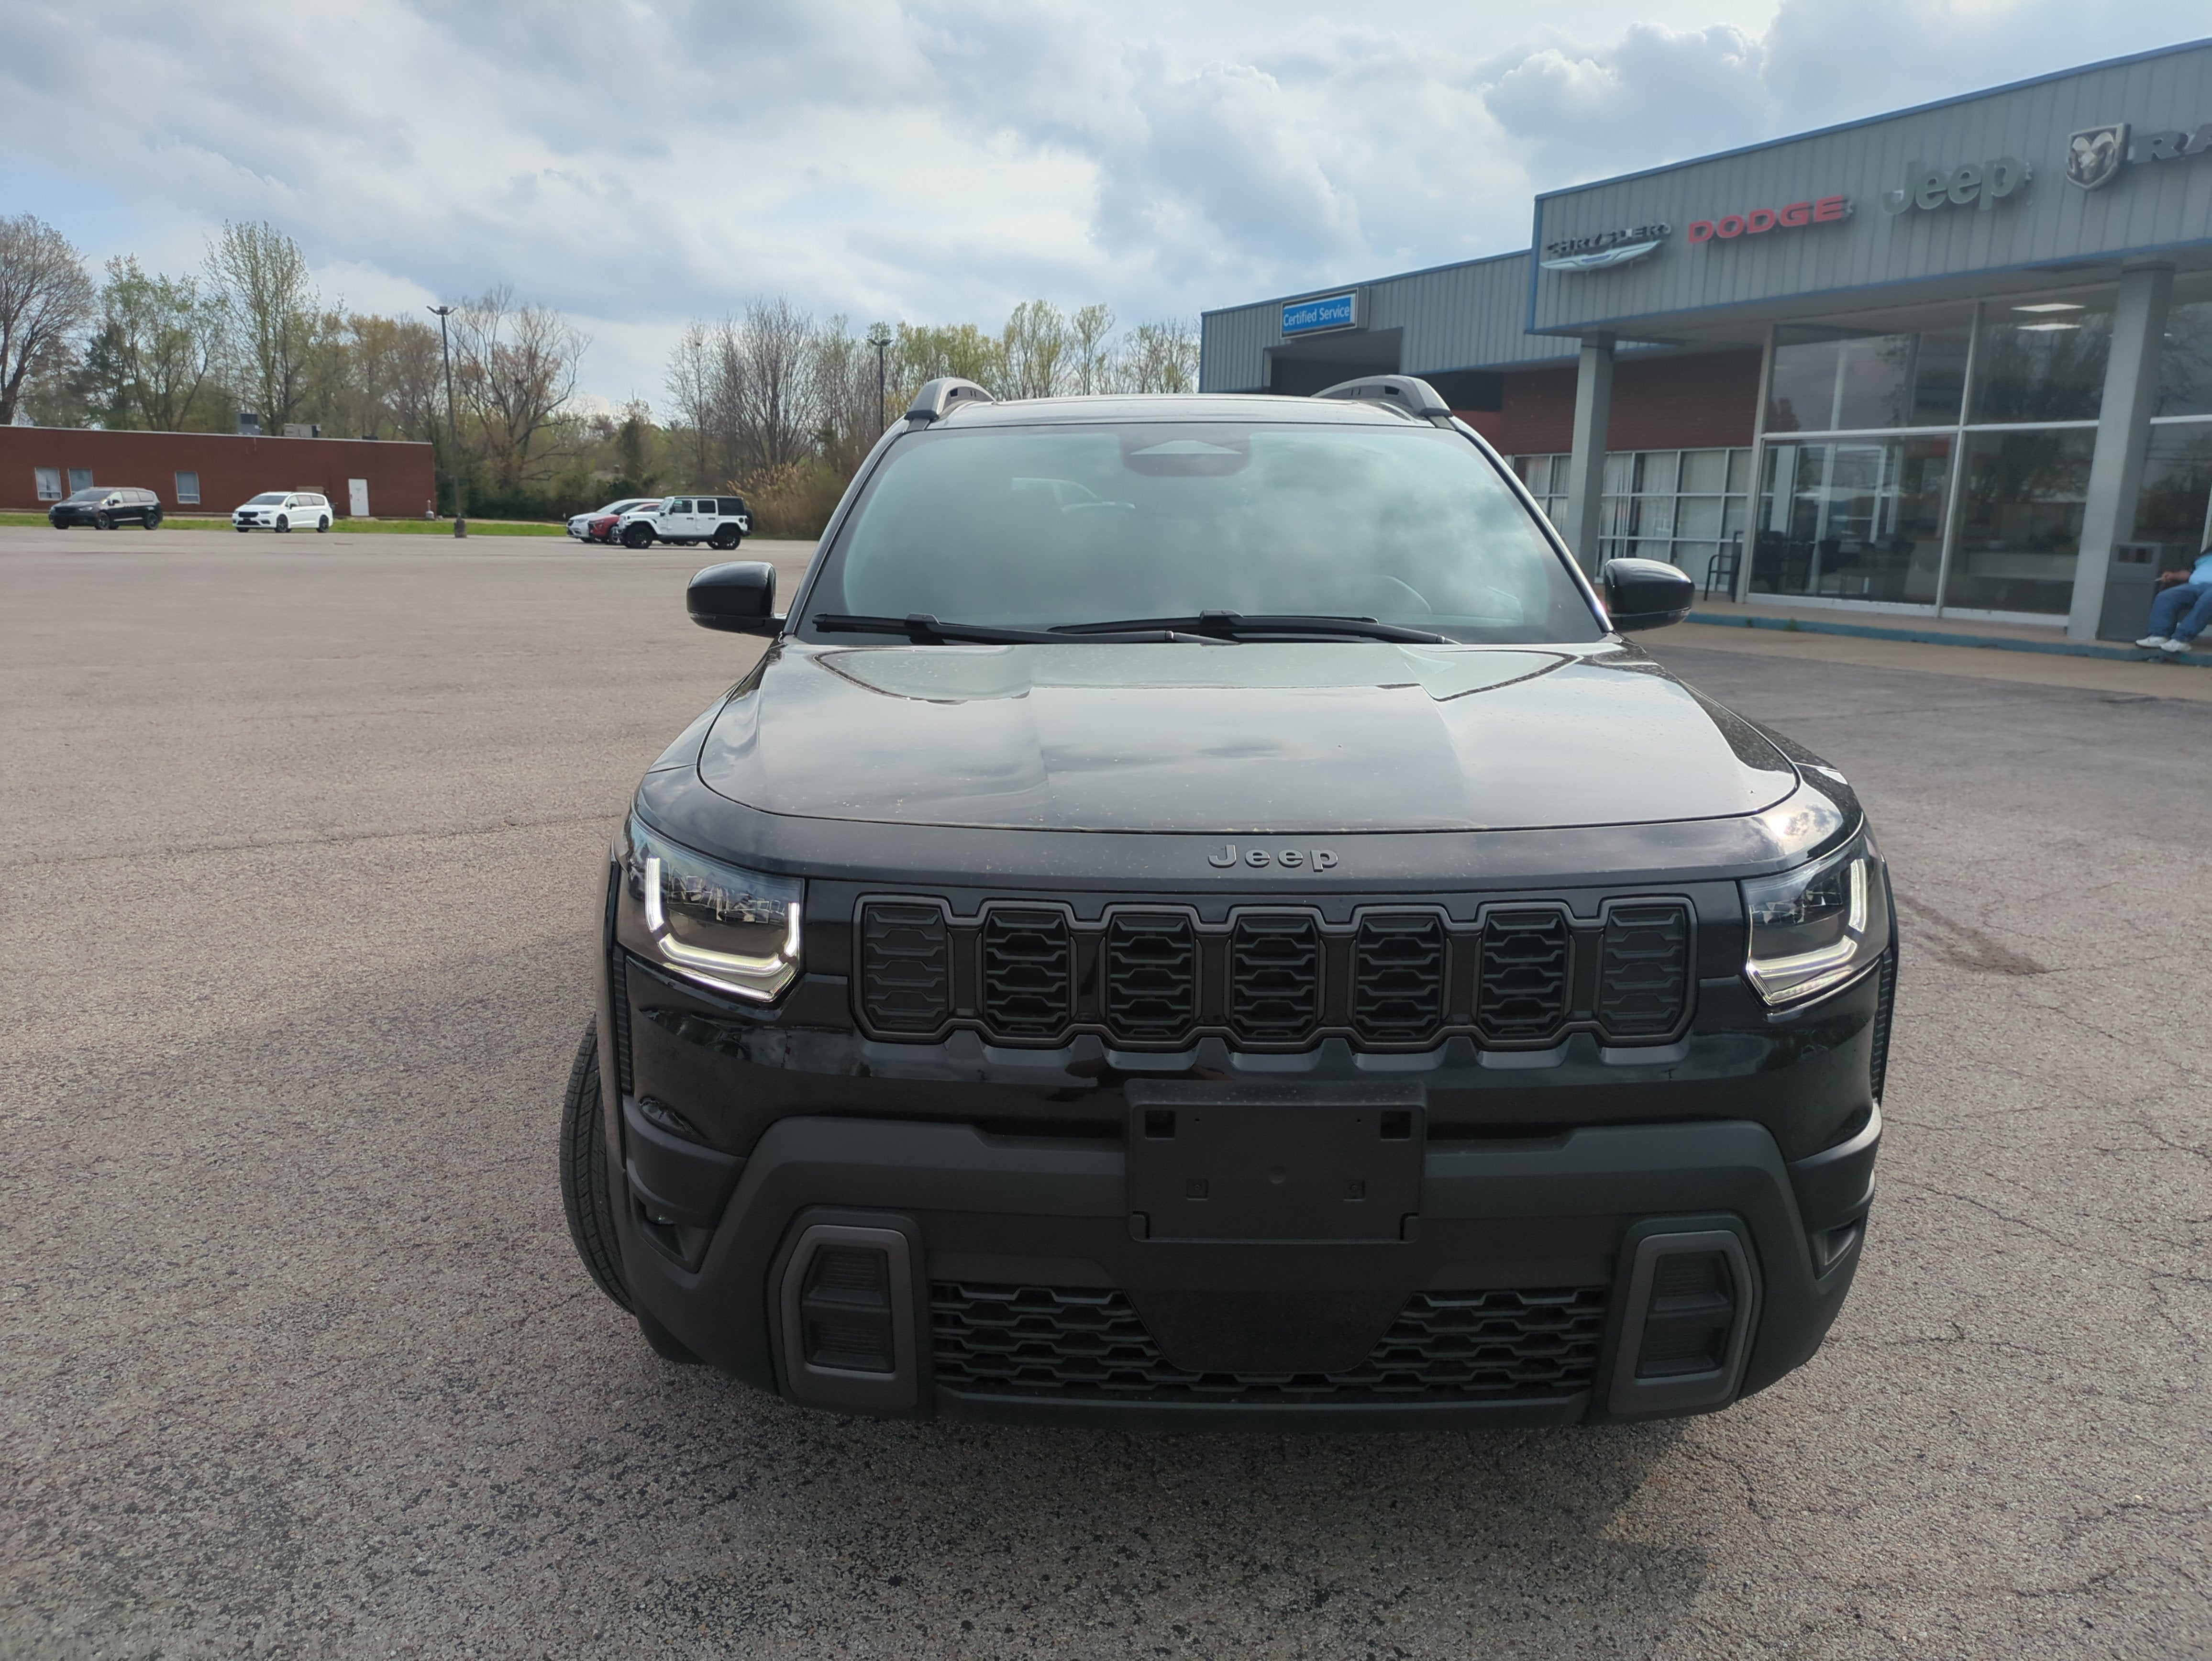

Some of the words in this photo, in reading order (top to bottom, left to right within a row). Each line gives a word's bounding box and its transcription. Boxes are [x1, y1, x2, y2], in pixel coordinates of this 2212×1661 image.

[1882, 157, 2020, 215] Jeep
[1689, 195, 1845, 244] DODGE
[1283, 309, 1317, 327] Certified
[1319, 305, 1350, 321] Service
[1207, 844, 1338, 872] Jeep
